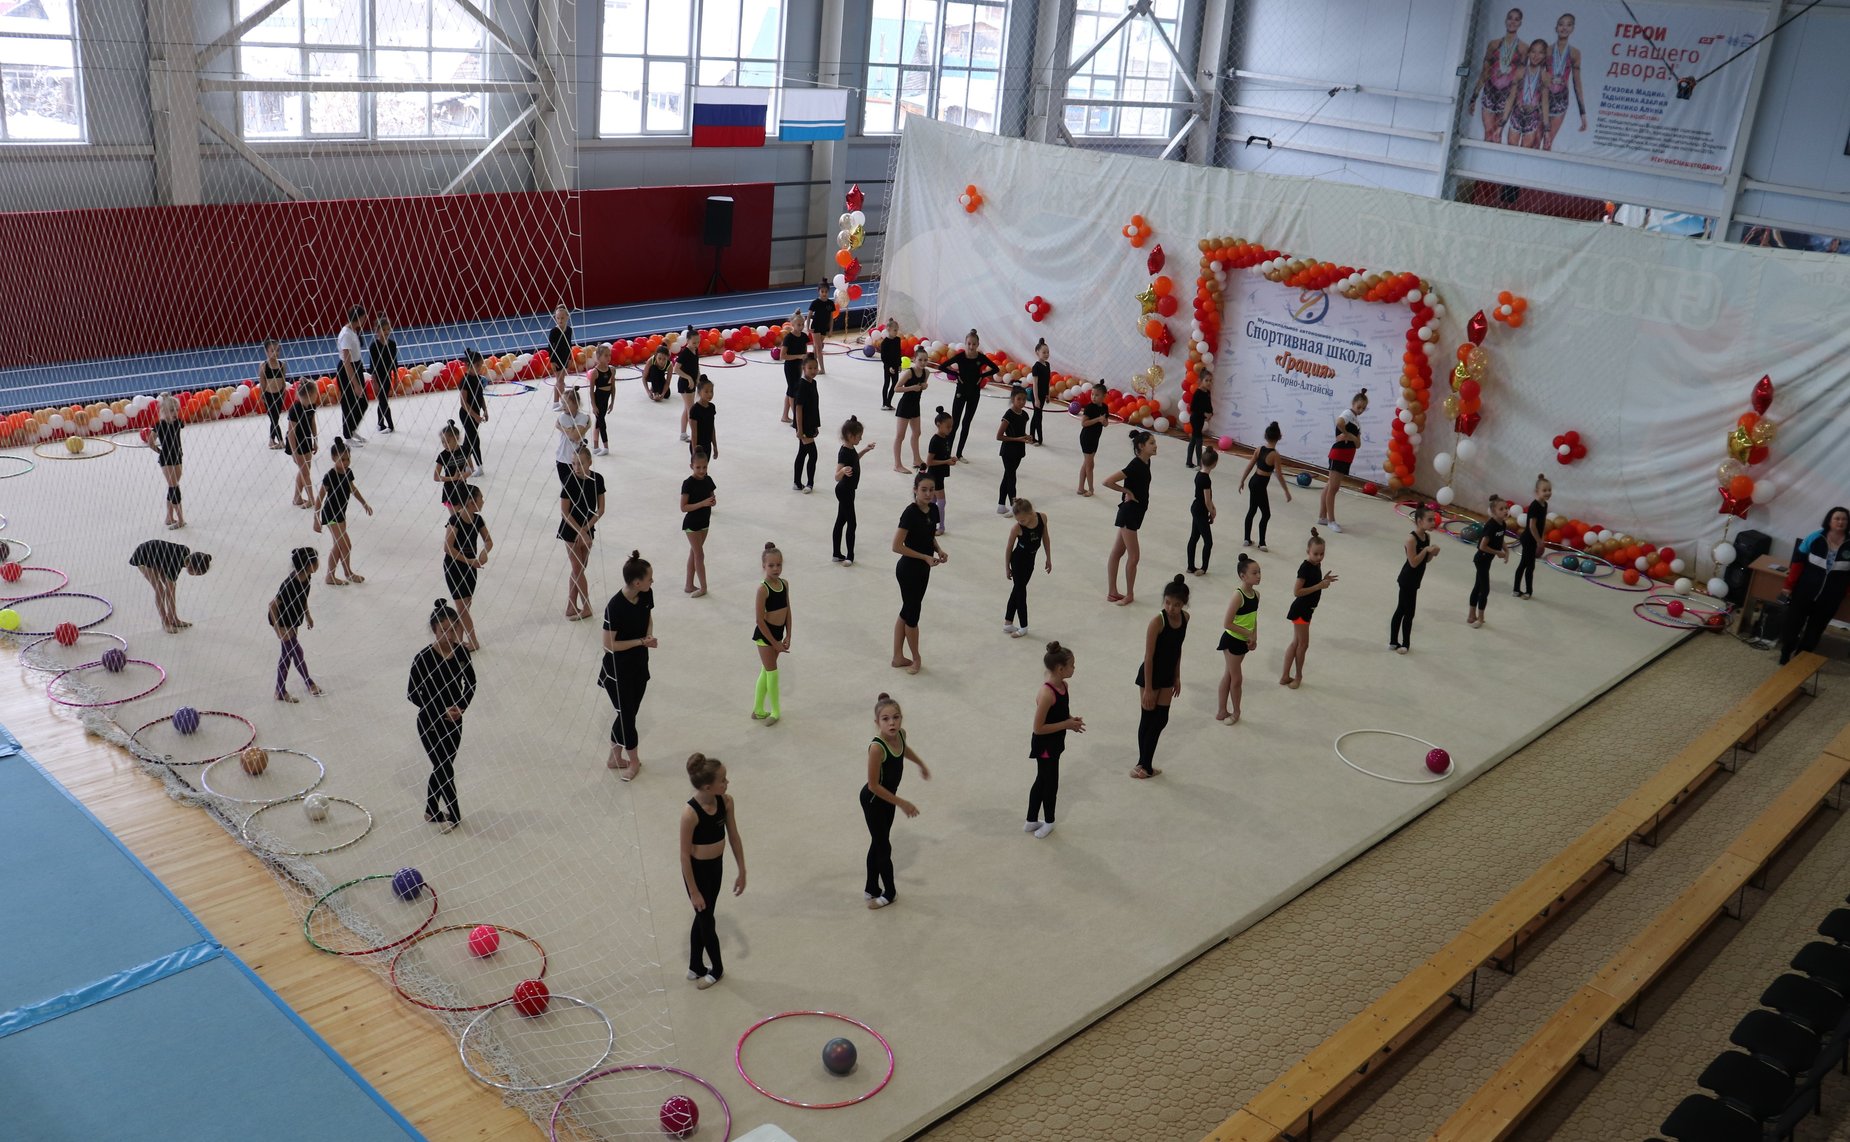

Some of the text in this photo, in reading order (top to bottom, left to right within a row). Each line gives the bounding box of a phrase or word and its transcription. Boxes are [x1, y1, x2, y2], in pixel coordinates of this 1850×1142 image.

[1614, 23, 1667, 42] ГЕРОИ
[1611, 43, 1700, 64] с нашего
[1607, 61, 1676, 82] двора!
[1246, 320, 1373, 367] Спортивная школа
[1257, 317, 1367, 348] Муниципальное автономное учреждение
[1275, 351, 1336, 379] «Грация»
